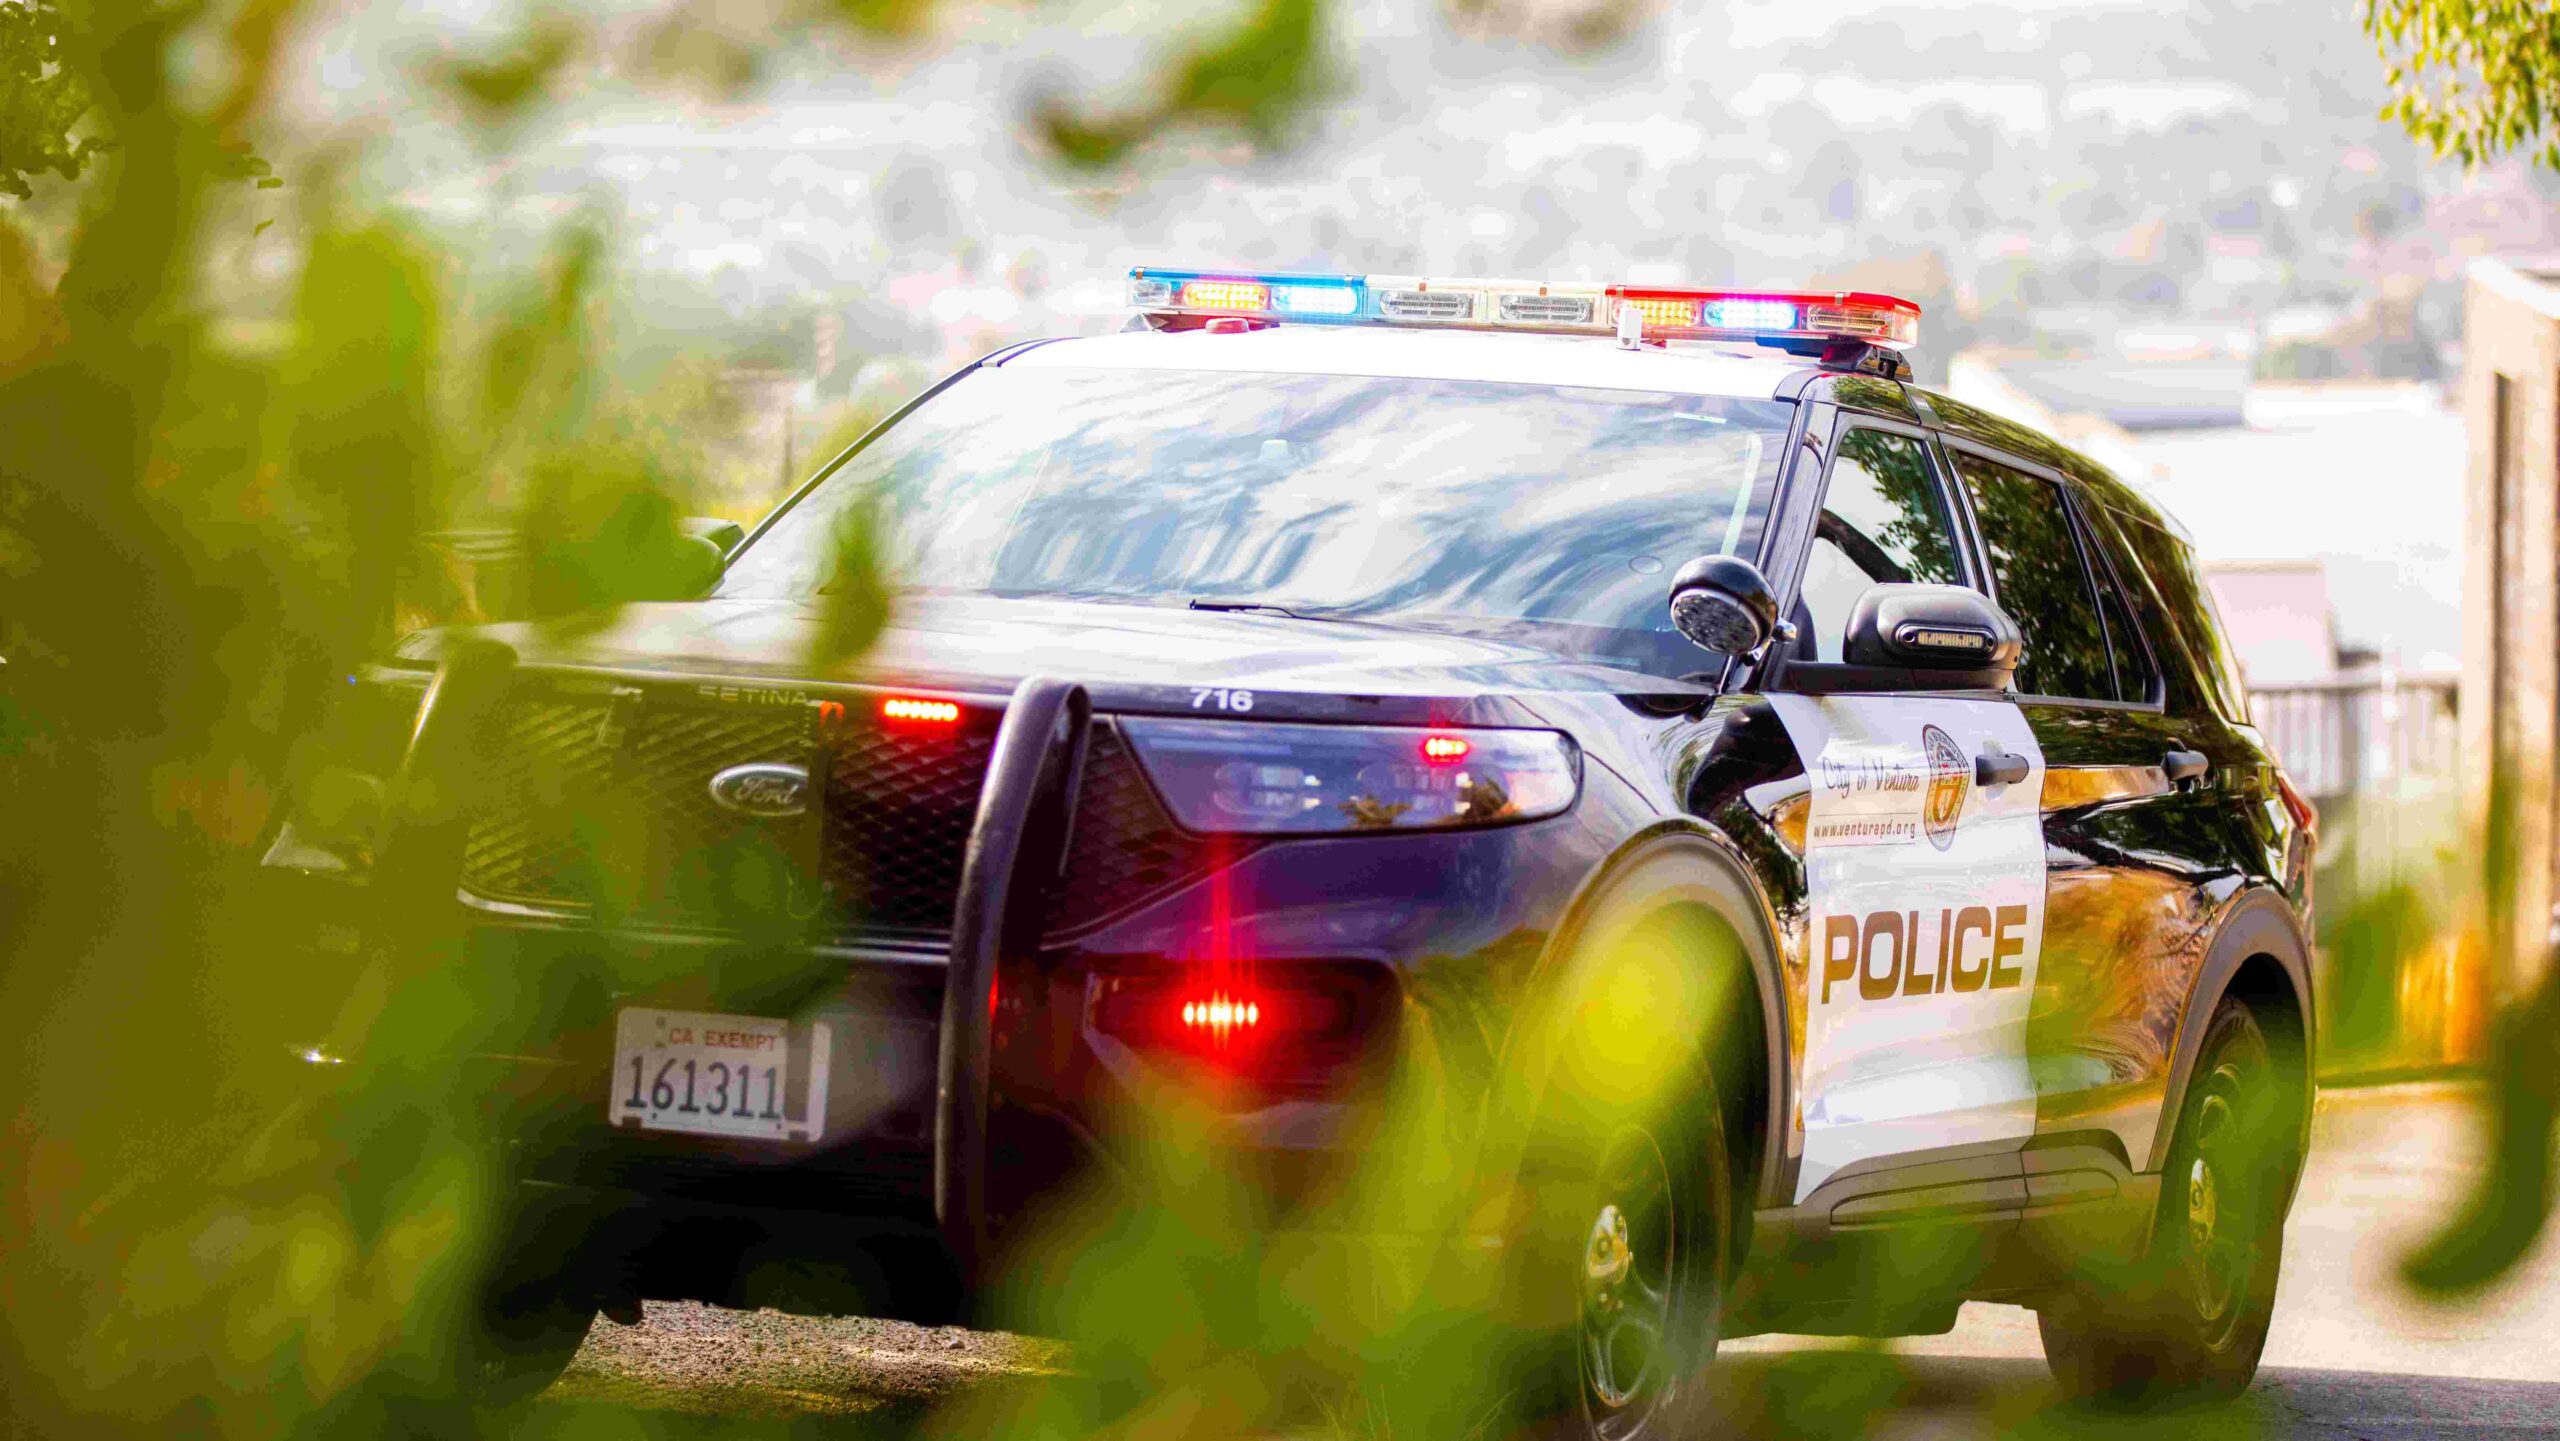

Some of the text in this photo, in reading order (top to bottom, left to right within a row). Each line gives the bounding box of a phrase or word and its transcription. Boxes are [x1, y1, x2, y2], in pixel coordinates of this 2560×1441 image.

[1190, 687, 1254, 712] 716
[735, 777, 799, 804] Ford
[1822, 756, 1850, 799] City
[1872, 757, 1919, 792] Ventura
[1813, 819, 1916, 839] www.venturapd.org
[1821, 904, 2028, 1005] POLICE
[669, 1028, 776, 1051] CA EXEMPT
[625, 1055, 781, 1119] 161311
